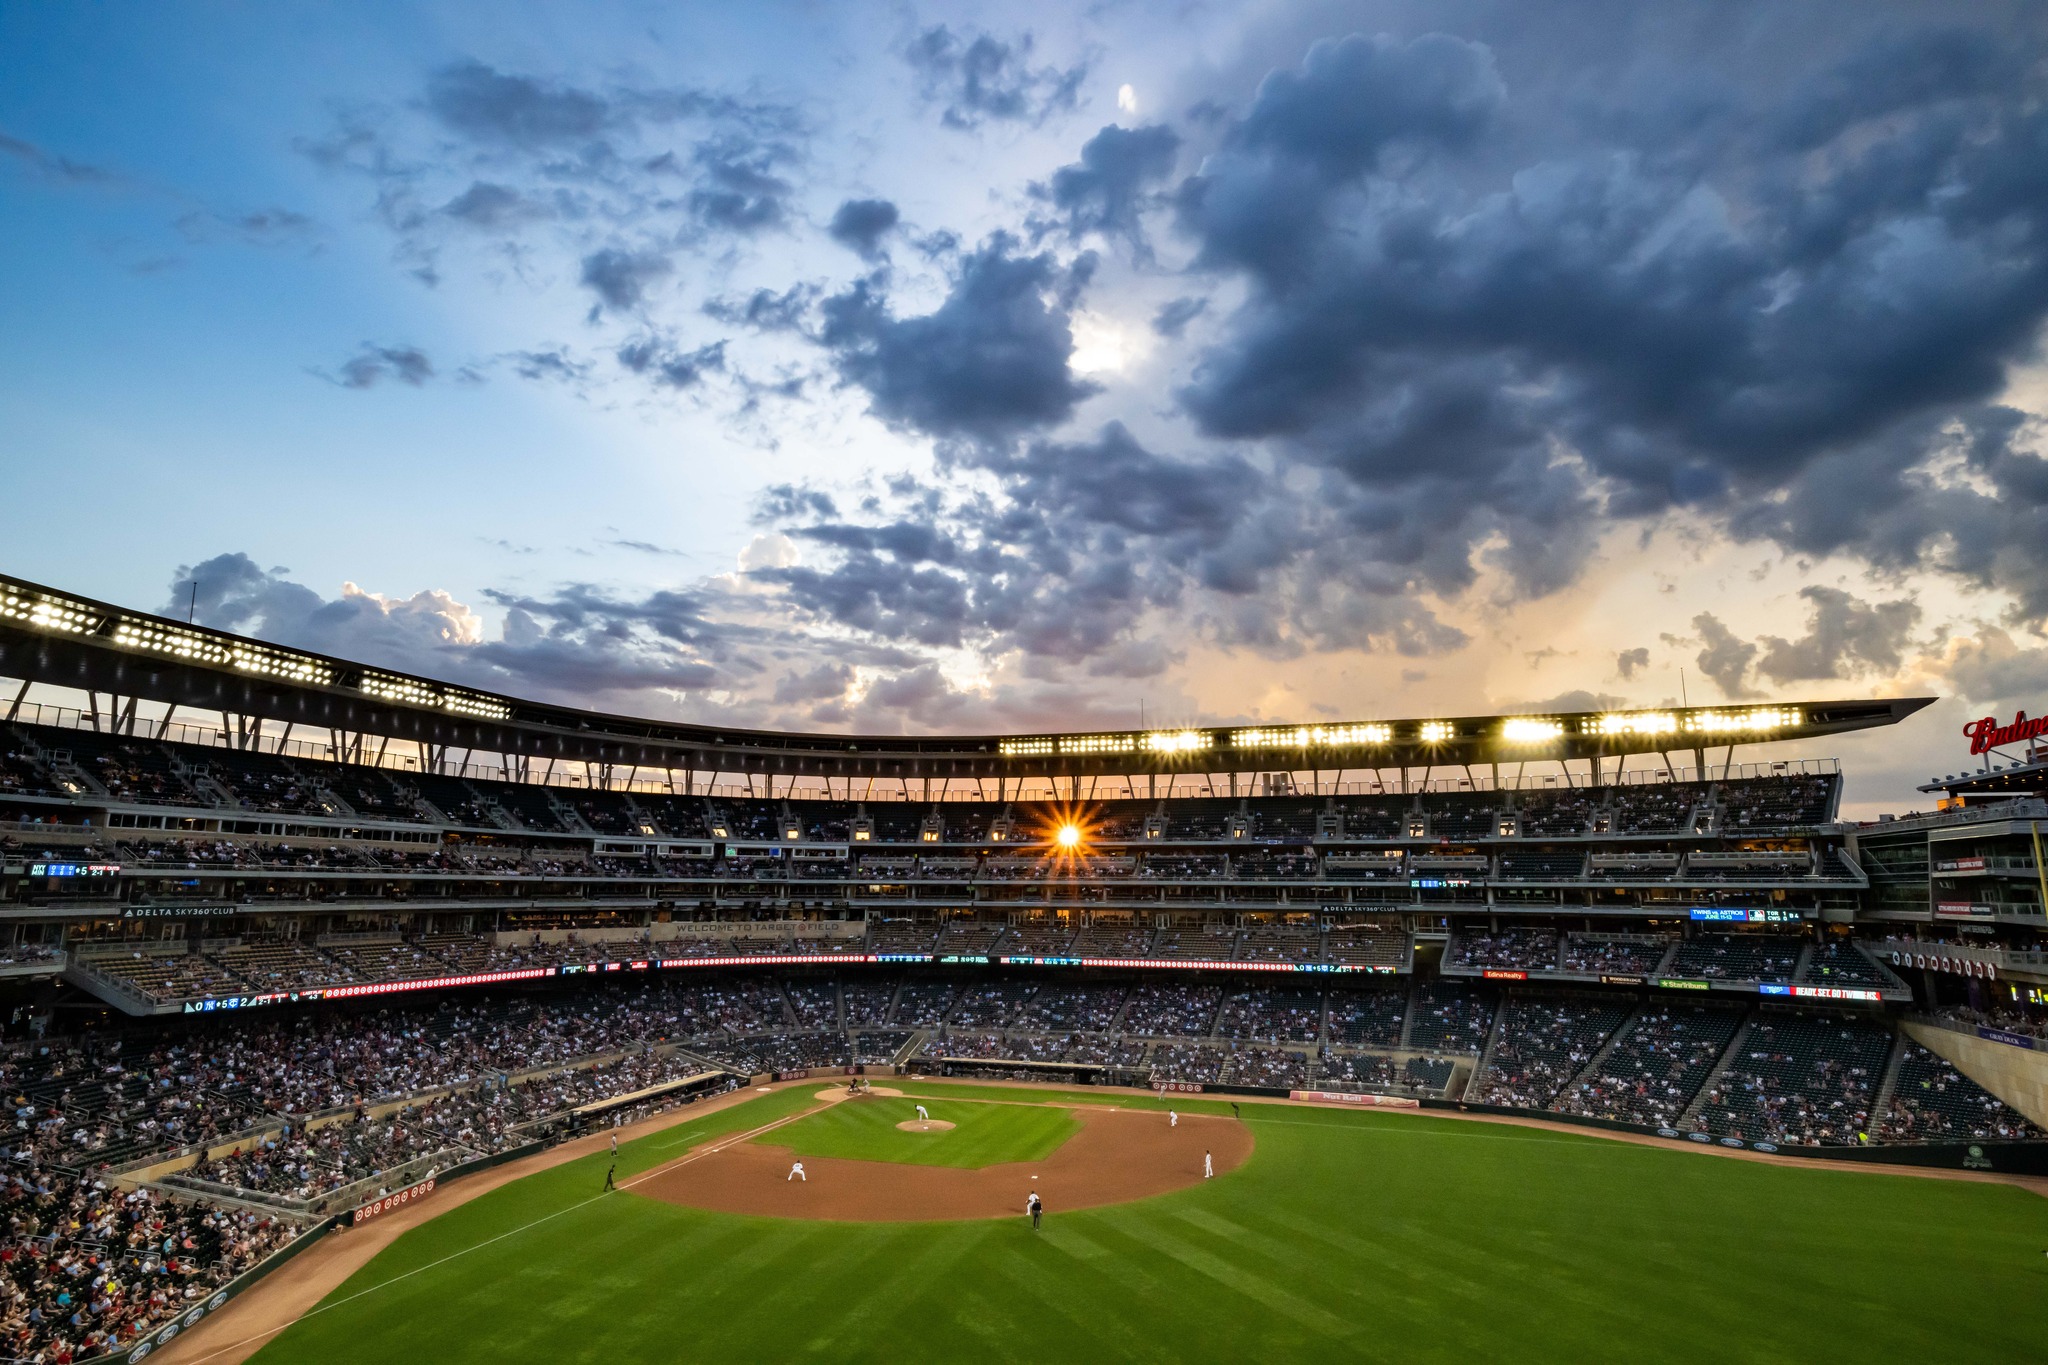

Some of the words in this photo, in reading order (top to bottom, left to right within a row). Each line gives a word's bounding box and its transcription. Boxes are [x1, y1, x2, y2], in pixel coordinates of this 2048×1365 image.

[81, 867, 87, 875] 5
[1832, 989, 1841, 998] GO
[195, 1002, 203, 1010] 0
[222, 1000, 228, 1008] 5
[240, 998, 247, 1006] 2
